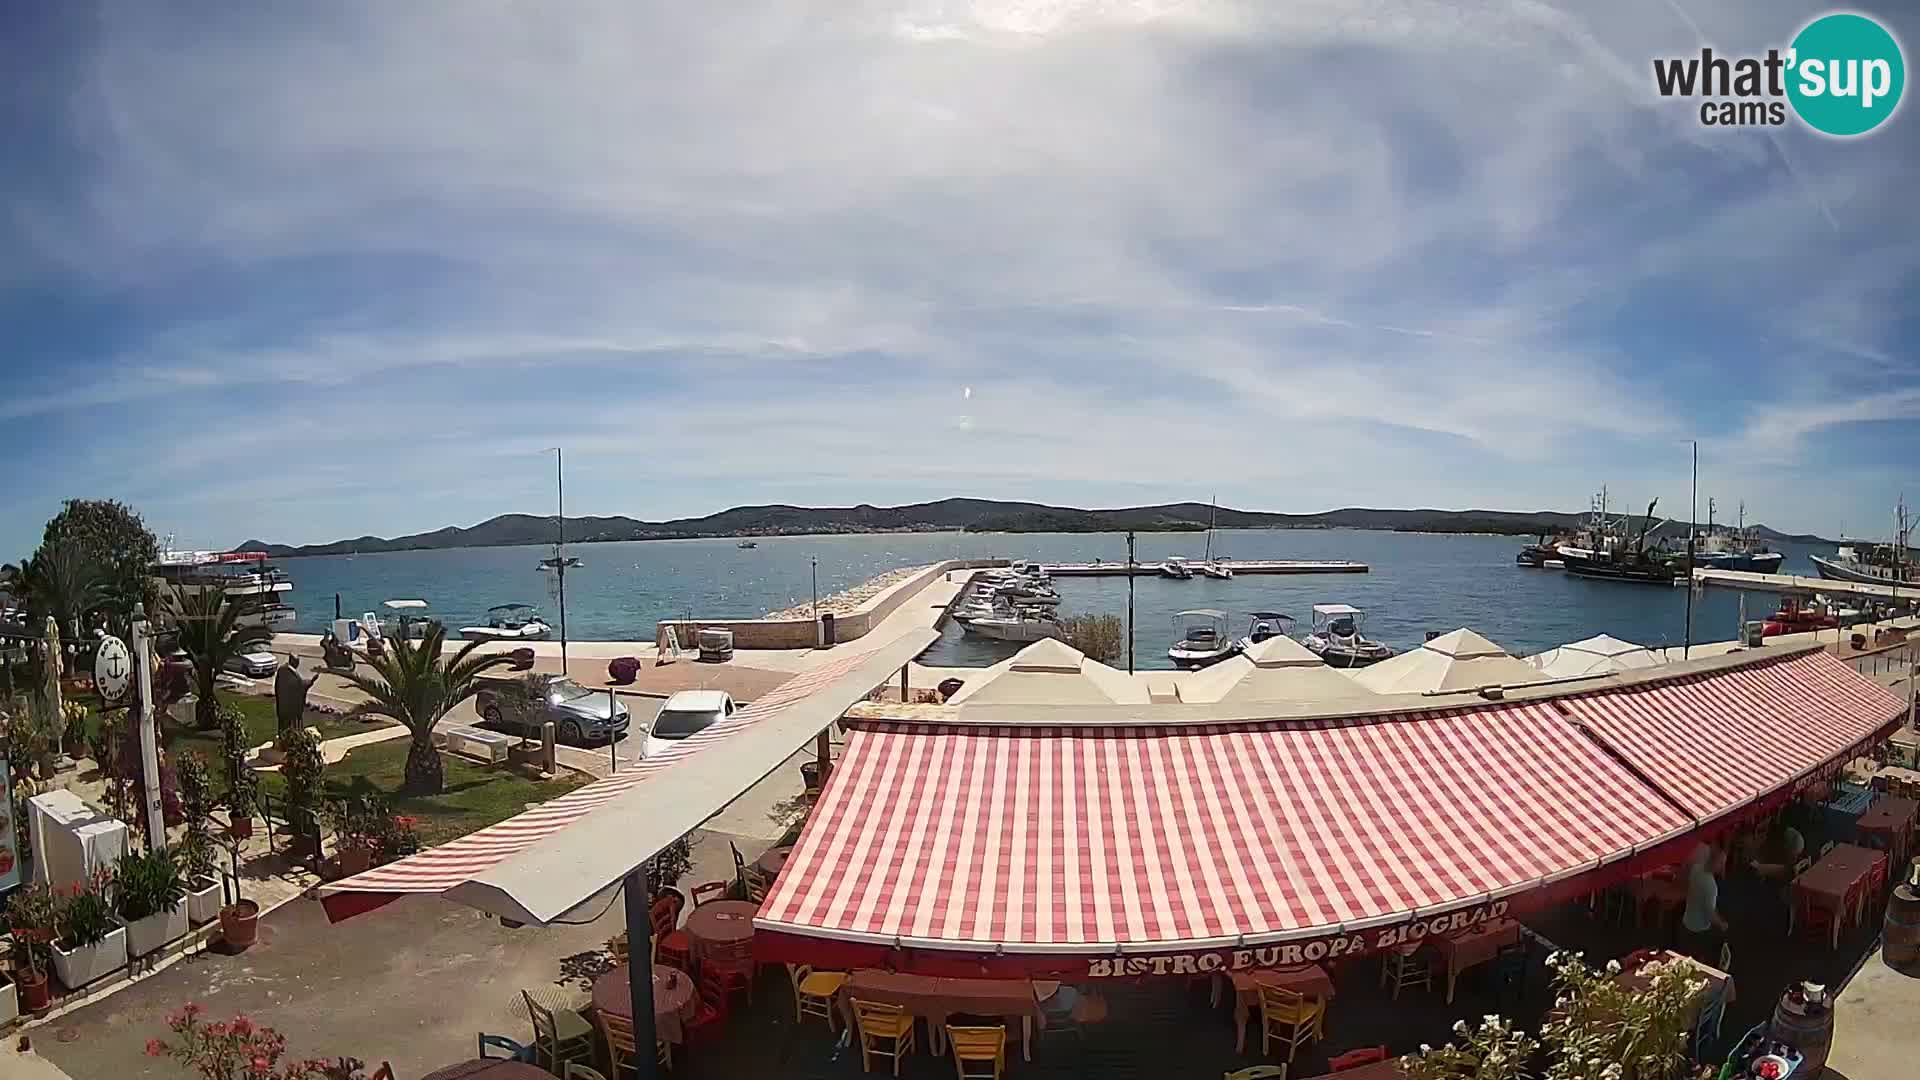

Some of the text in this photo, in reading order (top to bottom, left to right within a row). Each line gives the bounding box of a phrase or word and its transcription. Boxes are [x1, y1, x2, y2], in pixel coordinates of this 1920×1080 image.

[1088, 901, 1508, 977] BISTRO EUROPA BIOGRAD
